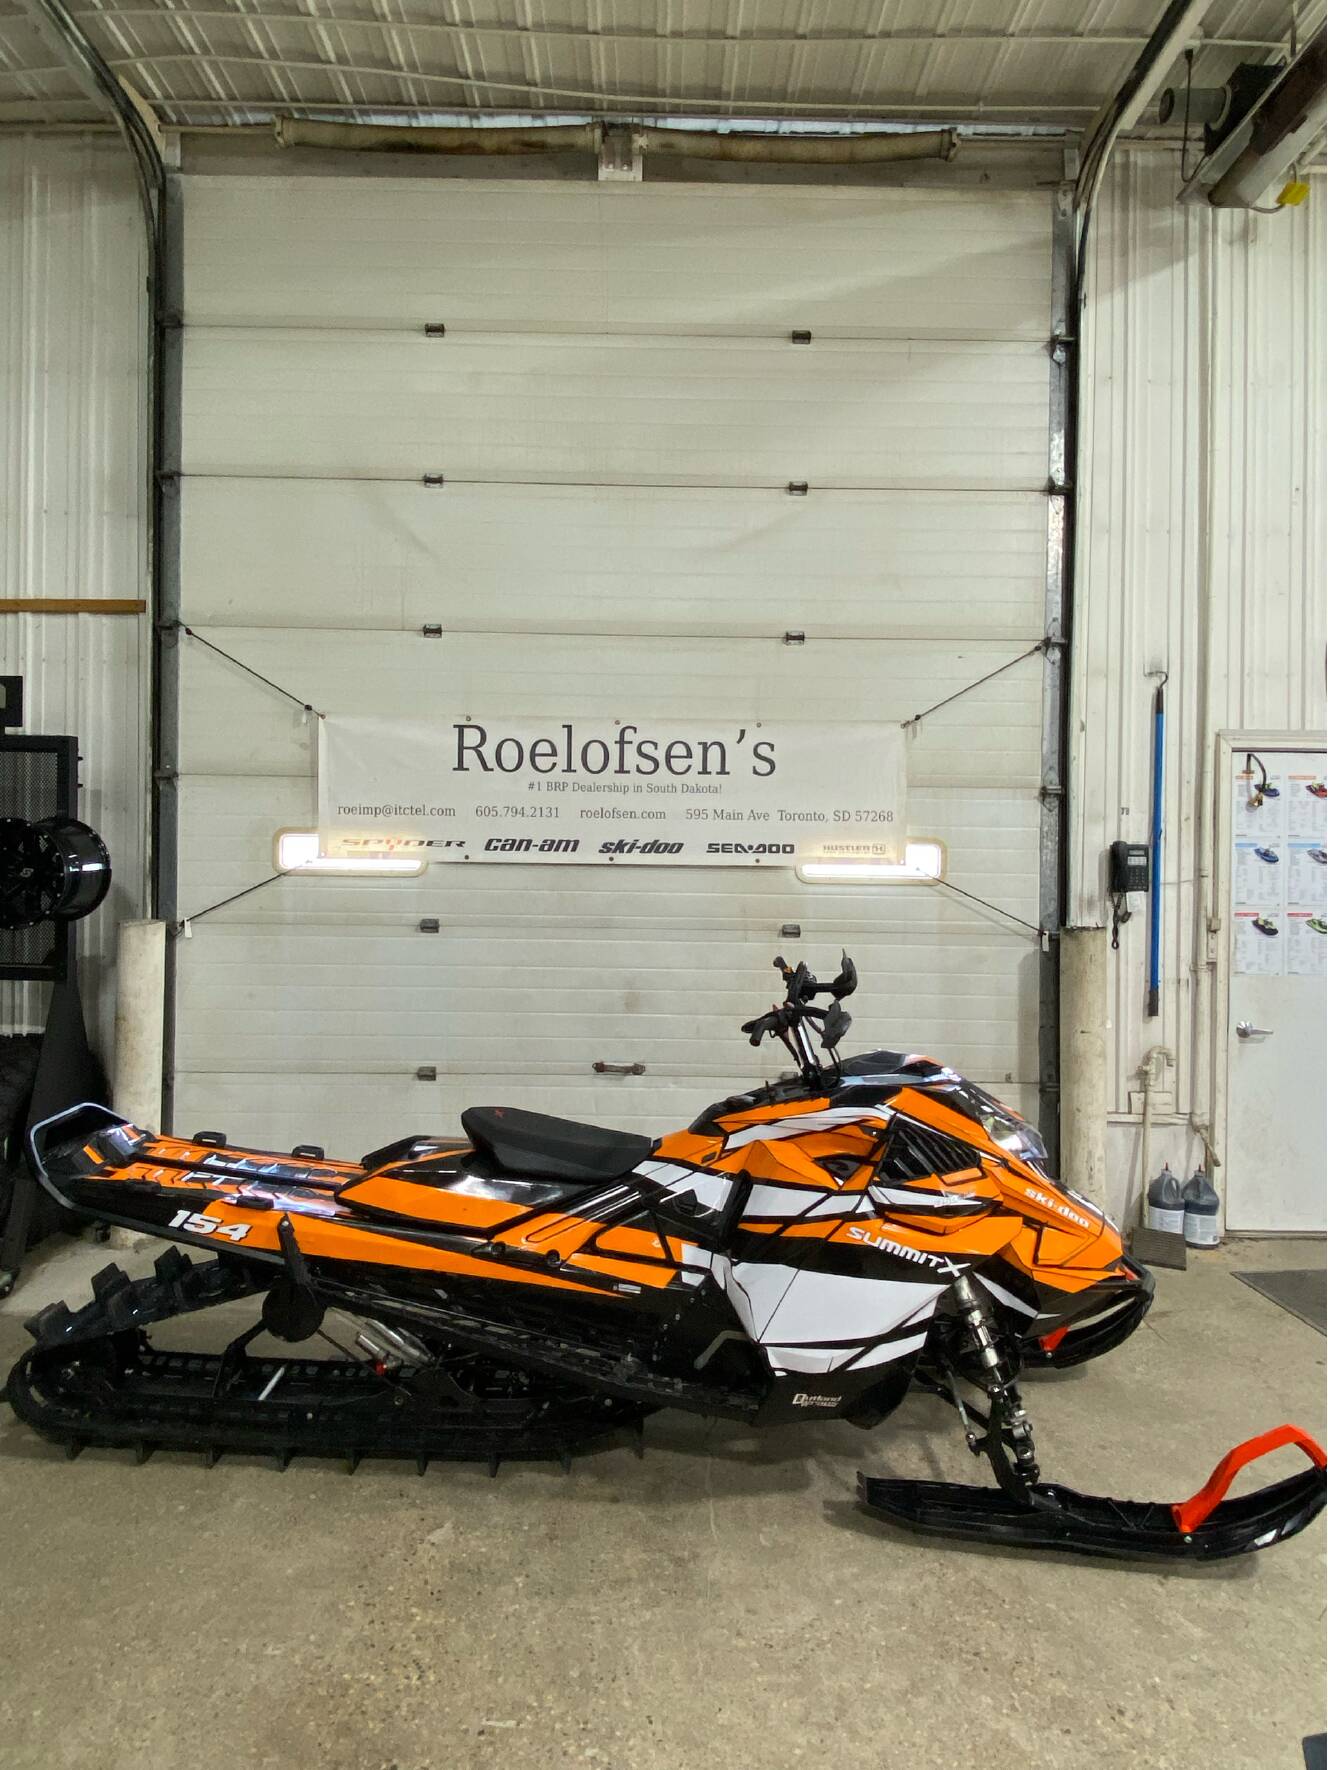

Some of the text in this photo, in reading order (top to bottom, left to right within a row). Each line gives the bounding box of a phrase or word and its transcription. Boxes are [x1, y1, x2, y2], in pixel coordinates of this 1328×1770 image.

[528, 781, 722, 795] #1 BRP Dealership in South Dakota!
[337, 804, 456, 817] roeimp@itctel.com
[475, 806, 560, 818] 605.794.2131
[580, 807, 666, 820] roelofsen.com
[685, 809, 894, 823] 595 Main Ave Toronto, SD 57268
[598, 839, 684, 854] ski-doo
[1025, 1187, 1090, 1229] ski-doo
[168, 1209, 252, 1242] 154
